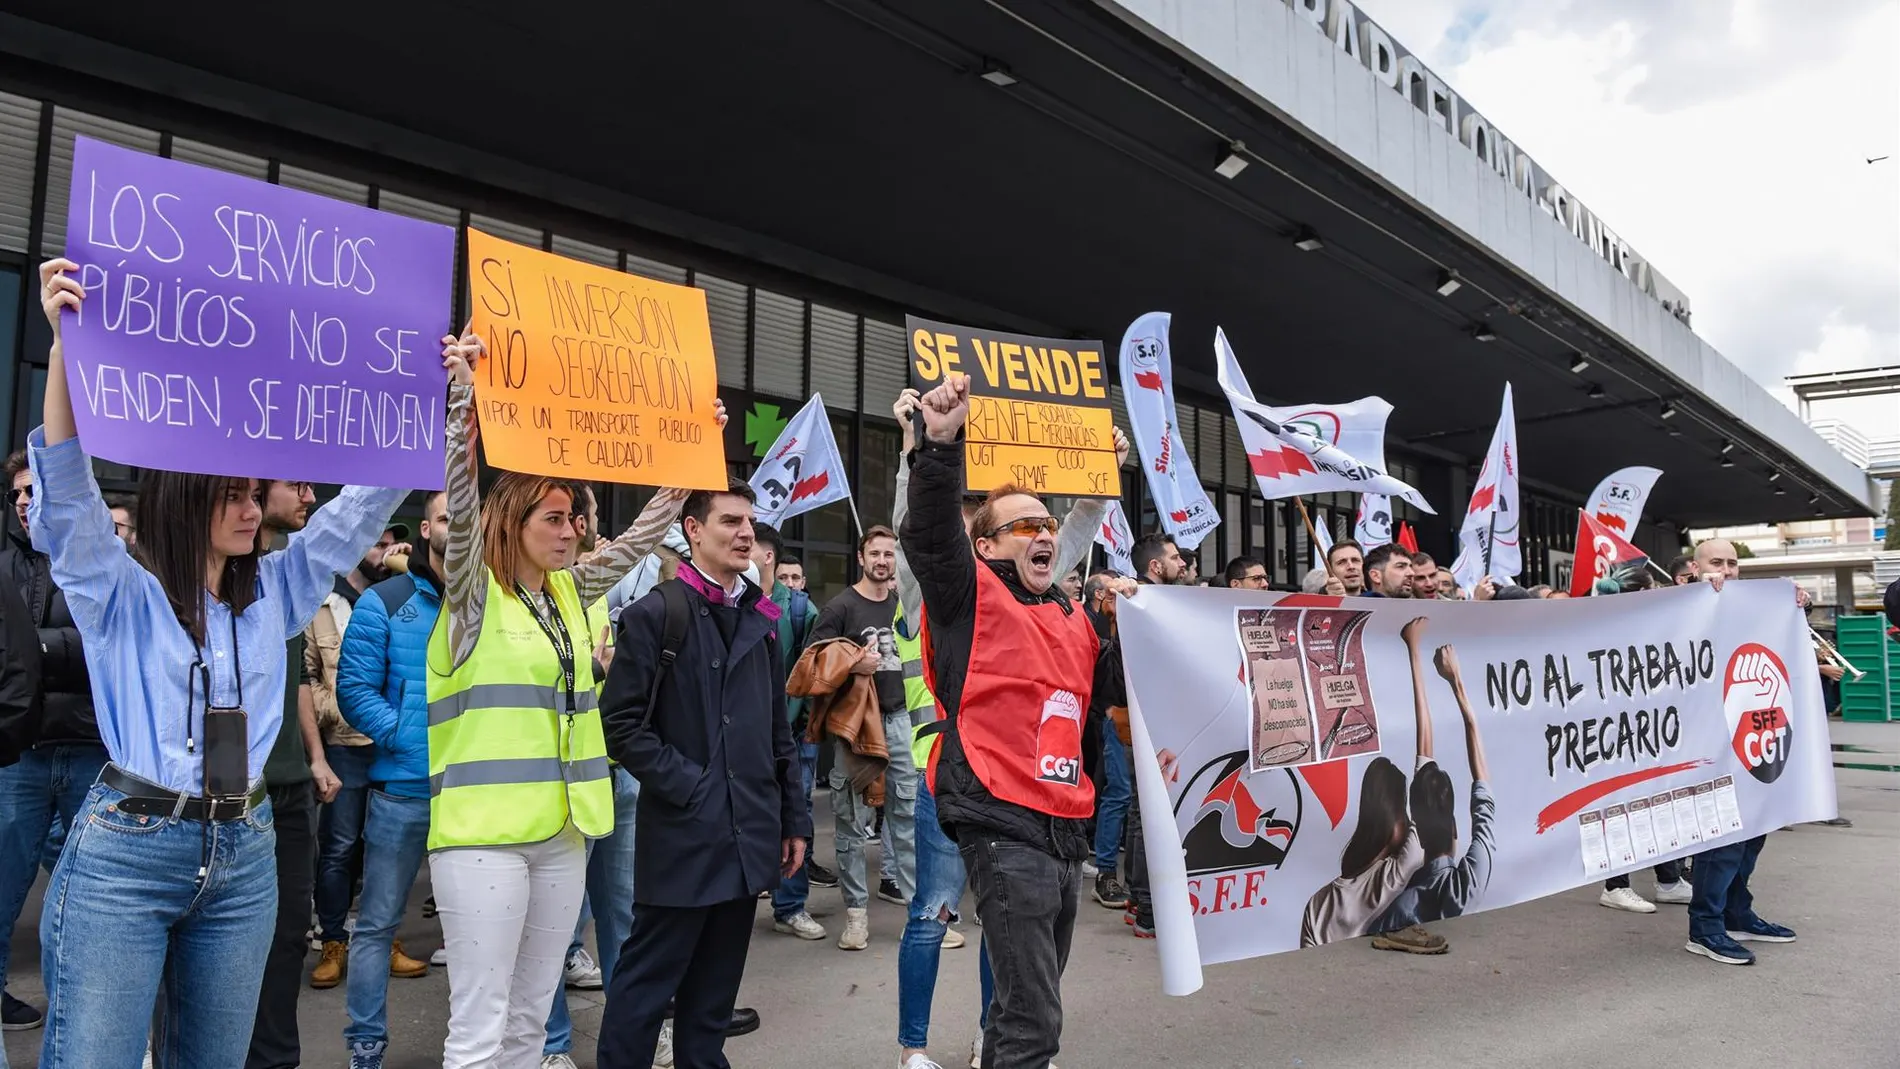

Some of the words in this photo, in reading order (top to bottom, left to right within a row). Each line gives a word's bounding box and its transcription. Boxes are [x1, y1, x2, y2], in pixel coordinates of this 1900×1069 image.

[88, 169, 184, 263] LOS
[290, 308, 347, 367] NO
[366, 327, 418, 377] SE
[489, 324, 527, 389] NO
[914, 328, 964, 381] SE
[971, 338, 1106, 399] VENDE
[78, 360, 233, 439] VENDEN,
[244, 377, 283, 440] SE
[533, 405, 551, 430] UN
[566, 409, 640, 437] TRANSPORTE
[968, 397, 1040, 444] RENFE
[548, 437, 571, 466] DE
[970, 444, 997, 466] UGT
[1057, 449, 1085, 470] CCOO
[1010, 464, 1049, 489] SEMAF
[1088, 472, 1109, 494] SCF
[1610, 487, 1630, 501] S.F.
[1247, 630, 1273, 640] HUELGA
[1266, 679, 1274, 690] La
[1274, 678, 1293, 692] huelga
[1326, 681, 1356, 693] HUELGA
[1486, 659, 1533, 710] NO
[1543, 654, 1584, 708] AL
[1587, 639, 1715, 700] TRABAJO
[1268, 698, 1277, 710] NO
[1286, 696, 1298, 709] sido
[1264, 716, 1307, 731] desconvocada
[1752, 710, 1777, 731] SFF
[1545, 706, 1681, 777] PRECARIO
[1744, 727, 1787, 767] CGT
[1040, 755, 1079, 781] CGT
